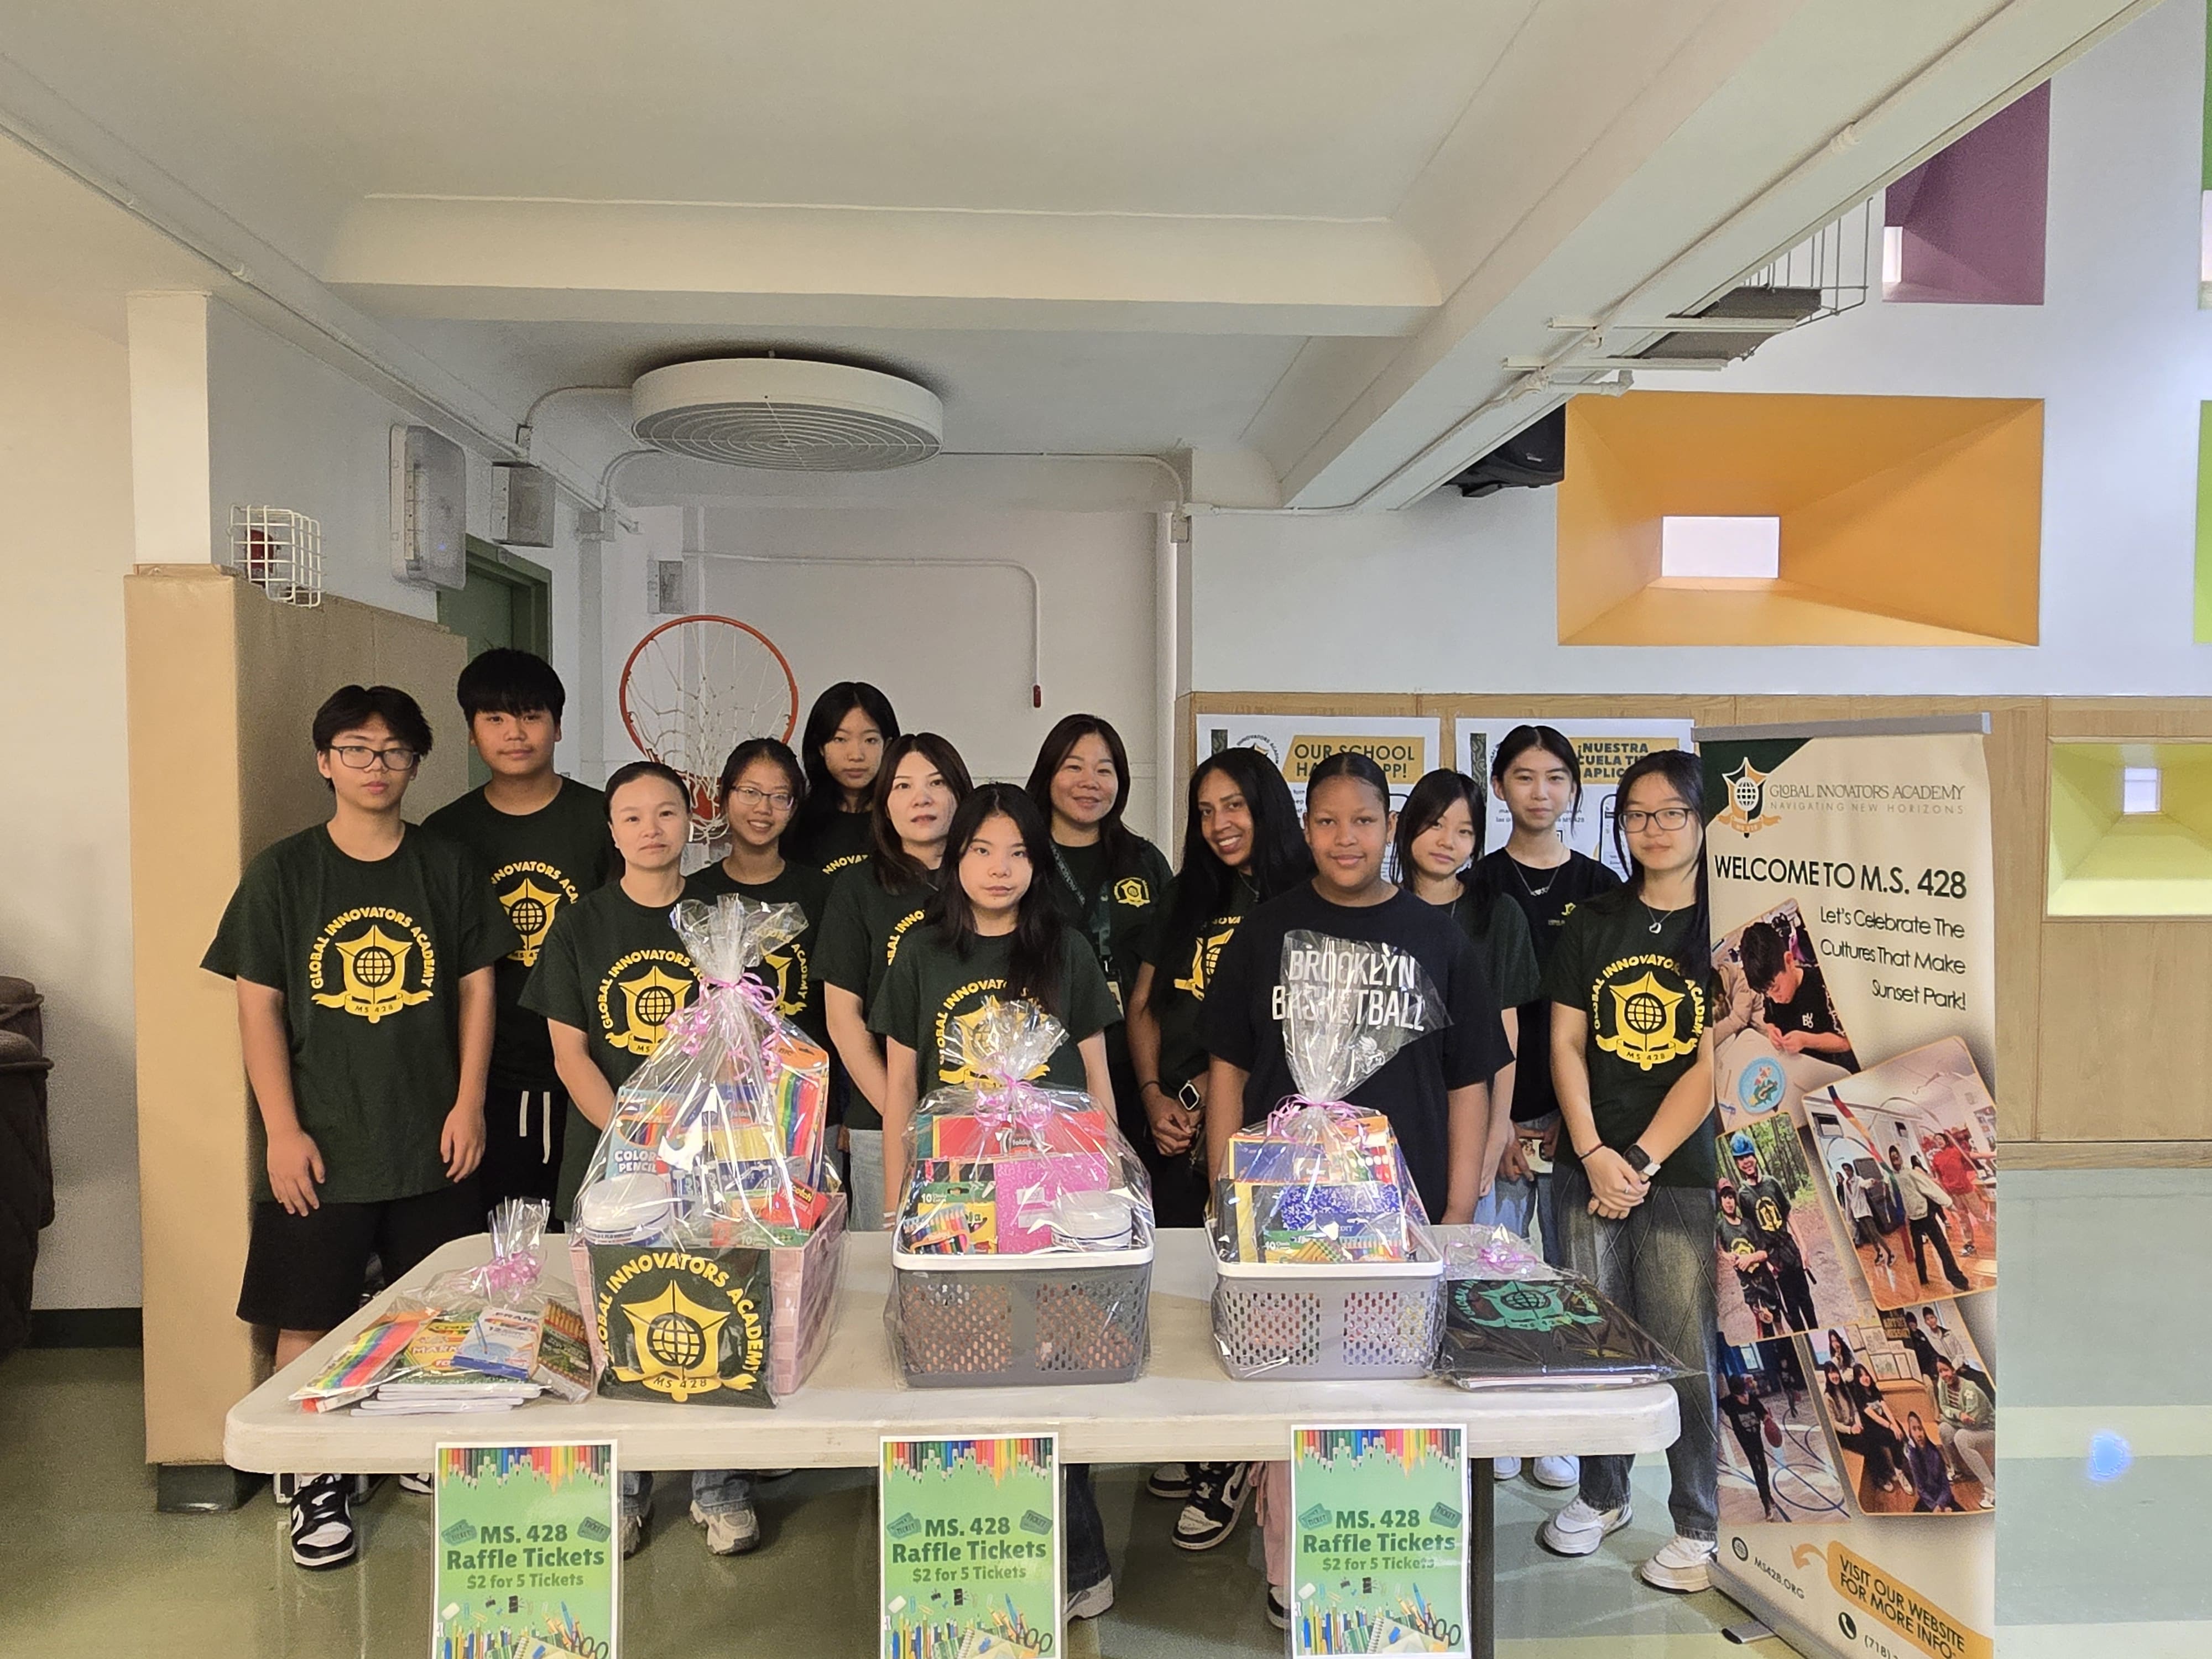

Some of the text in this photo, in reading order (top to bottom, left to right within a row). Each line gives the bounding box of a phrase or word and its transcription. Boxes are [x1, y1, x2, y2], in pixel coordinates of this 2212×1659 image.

[1294, 744, 1332, 759] OUR
[1579, 755, 1622, 765] CUELA
[1383, 763, 1407, 778] PP!
[1769, 784, 1966, 801] GLOBAL INNOVATORS ACADEMY
[1770, 802, 1964, 815] NAVIGATING NEW HORIZONS
[491, 861, 562, 884] NOVATORS
[1714, 854, 1968, 899] WELCOME TO M.S. 428
[1820, 906, 1965, 939] Let's Celebrate The
[309, 907, 435, 989] GLOBAL INNOVATORS ACADEMY
[1820, 938, 1966, 974] Cultures That Make
[791, 943, 809, 999] ACADEMY
[1288, 950, 1416, 989] BROOKLYN
[597, 978, 613, 1029] GLOBAL
[608, 950, 691, 978] INNOVATORS
[1602, 953, 1681, 979] INNOVATOR
[1684, 979, 1705, 1037] ACADEM
[1871, 979, 1966, 1011] Sunset Park!
[374, 1004, 394, 1013] 428
[1272, 985, 1425, 1032] BASKETBALL
[1626, 1051, 1666, 1061] MS 428
[793, 1185, 813, 1202] cotch
[921, 1192, 932, 1203] 10
[606, 1252, 730, 1294] INNOVATORS
[726, 1287, 764, 1373] ACADEM
[653, 1376, 707, 1389] MS 428
[925, 1518, 965, 1537] MS.
[969, 1517, 1010, 1536] 428
[1335, 1510, 1376, 1530] MS.
[1380, 1509, 1420, 1528] 428
[481, 1526, 521, 1544] MS.
[526, 1524, 568, 1543] 428
[1303, 1532, 1456, 1553] Raffle Tickets
[446, 1547, 605, 1570] Raffle Tickets
[892, 1540, 1047, 1564] Raffle Tickets
[912, 1565, 1027, 1583] $2 for 5 Tickets
[1322, 1556, 1435, 1571] $2 for 5 Tickets
[467, 1572, 585, 1590] $2 for 5 Tickets
[1754, 1556, 1805, 1600] MS428.ORG
[1840, 1572, 1867, 1603] FOR
[1870, 1593, 1914, 1635] MORE
[1840, 1554, 1966, 1655] VISIT OUR WEBSITE
